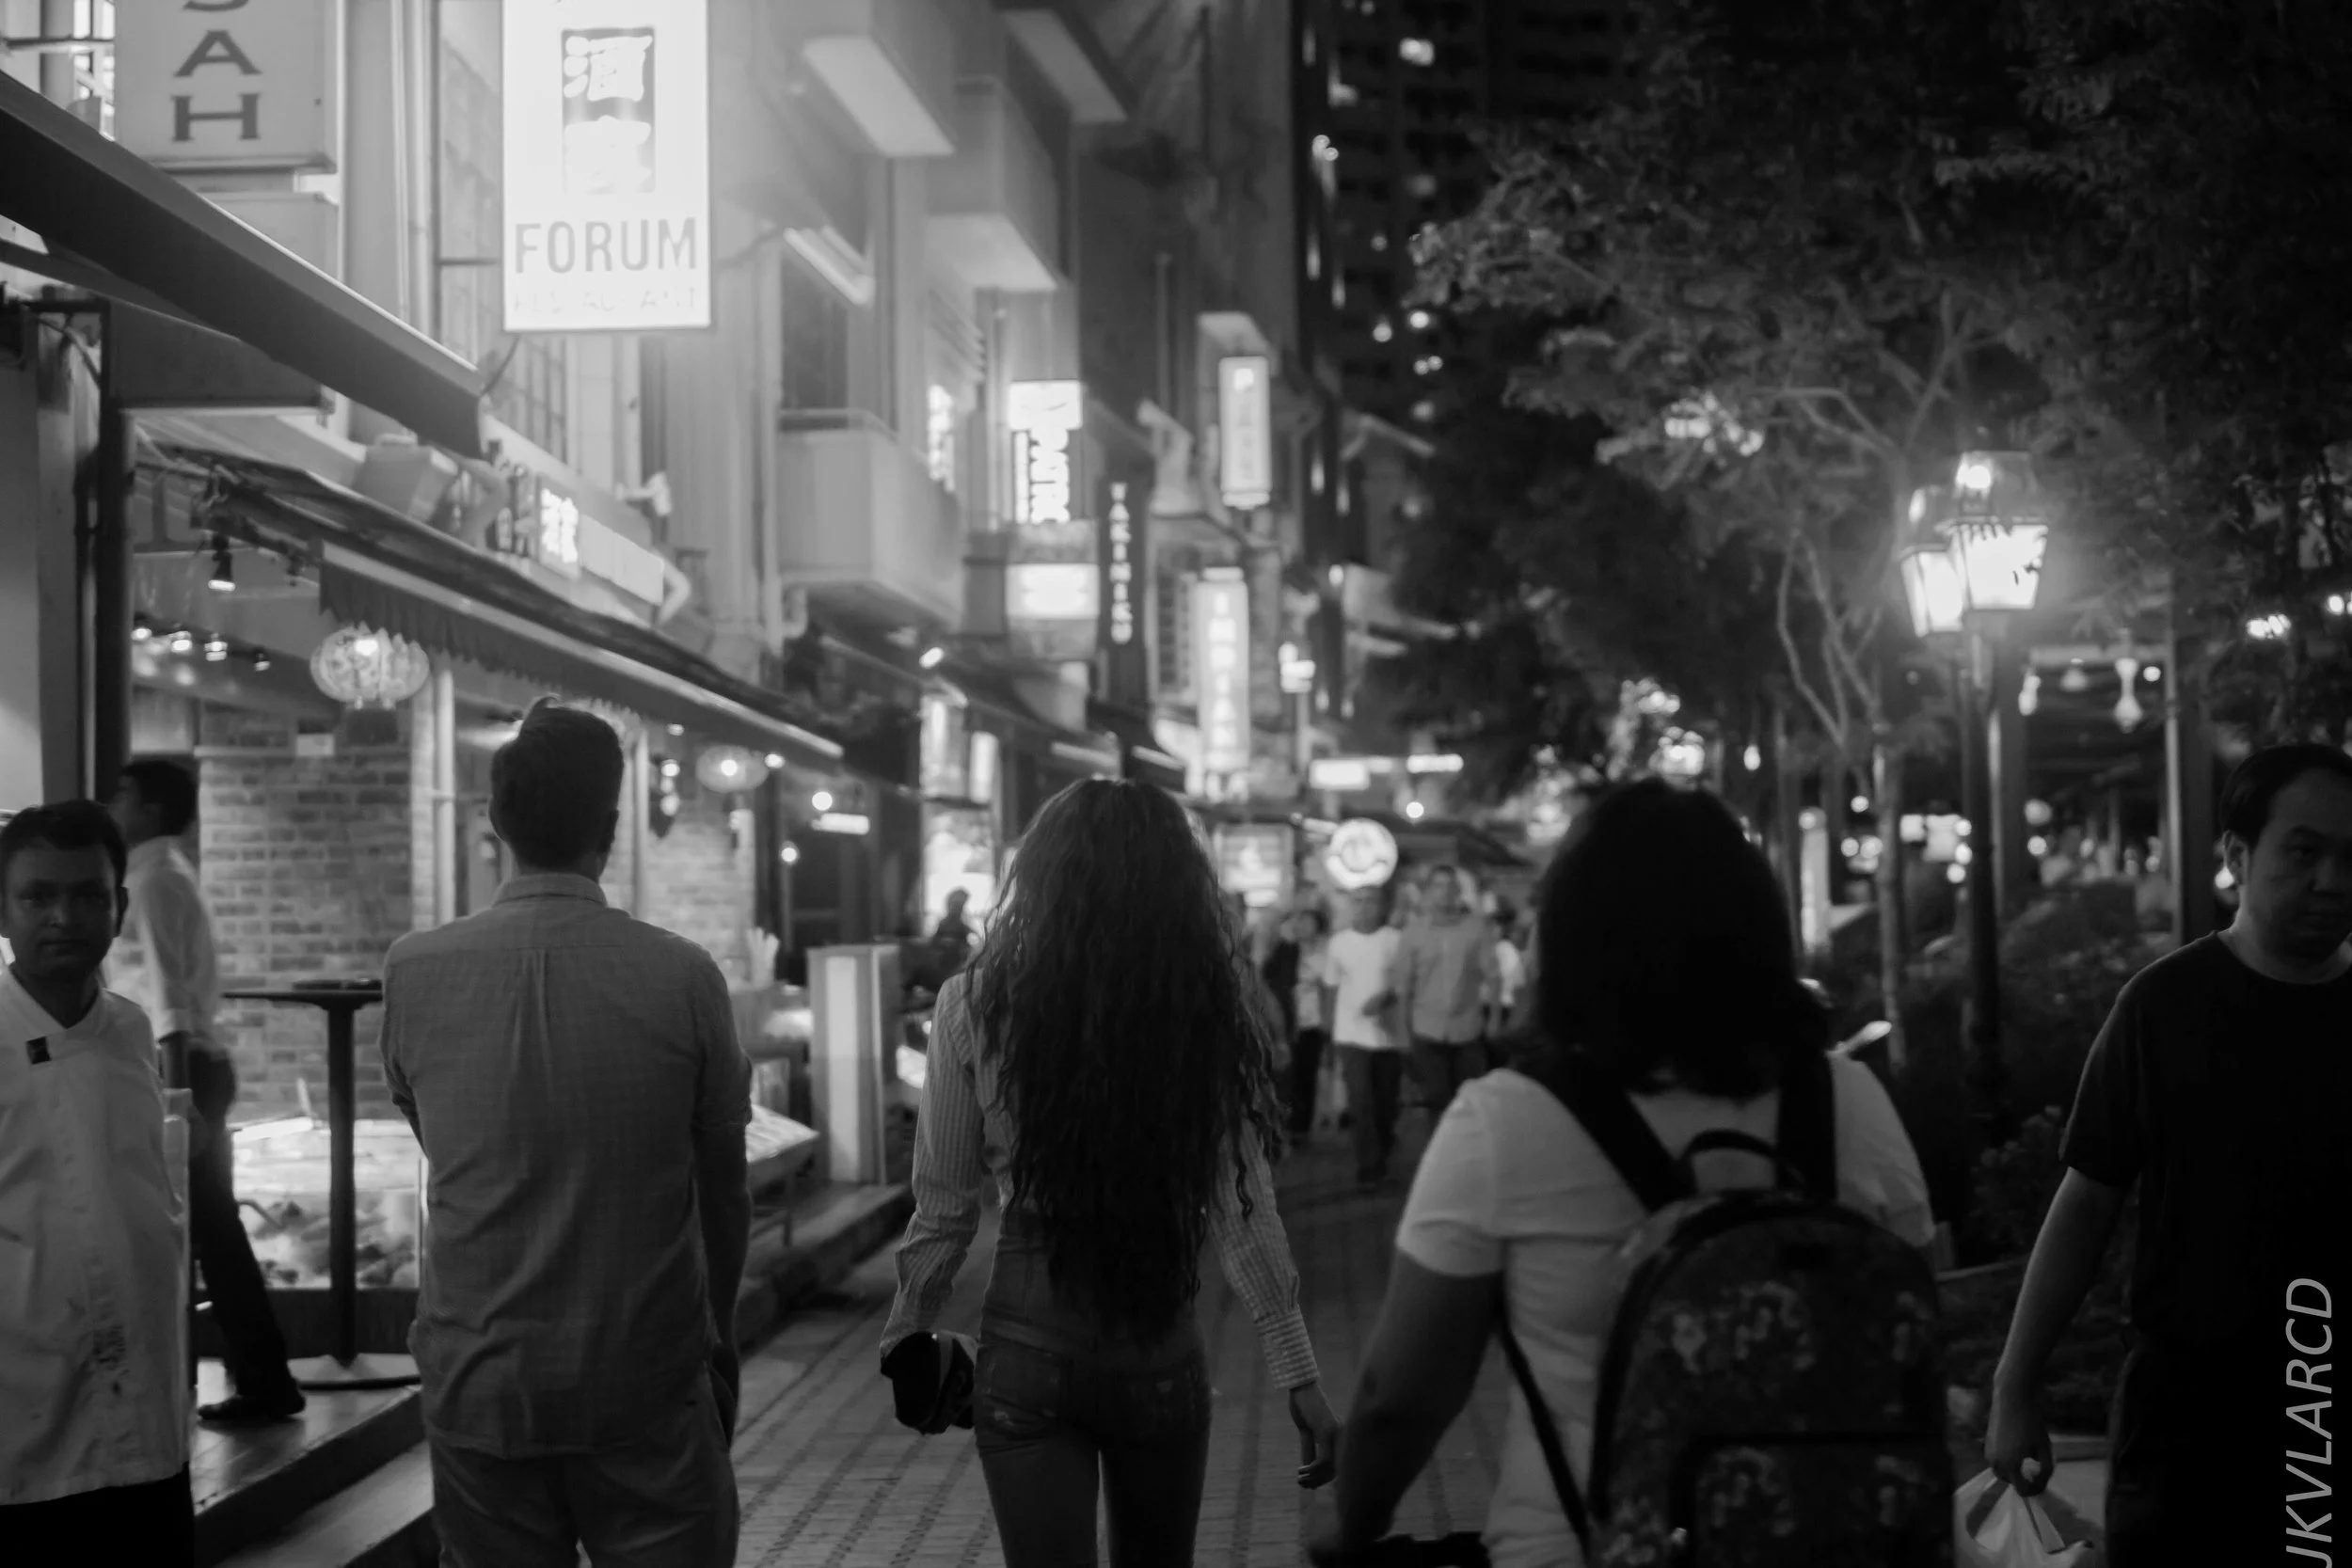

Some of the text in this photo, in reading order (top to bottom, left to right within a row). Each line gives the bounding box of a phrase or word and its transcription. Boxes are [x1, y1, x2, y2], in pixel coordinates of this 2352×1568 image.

[172, 0, 262, 141] AH
[515, 217, 697, 274] FORUM
[514, 285, 696, 315] RSAUAT
